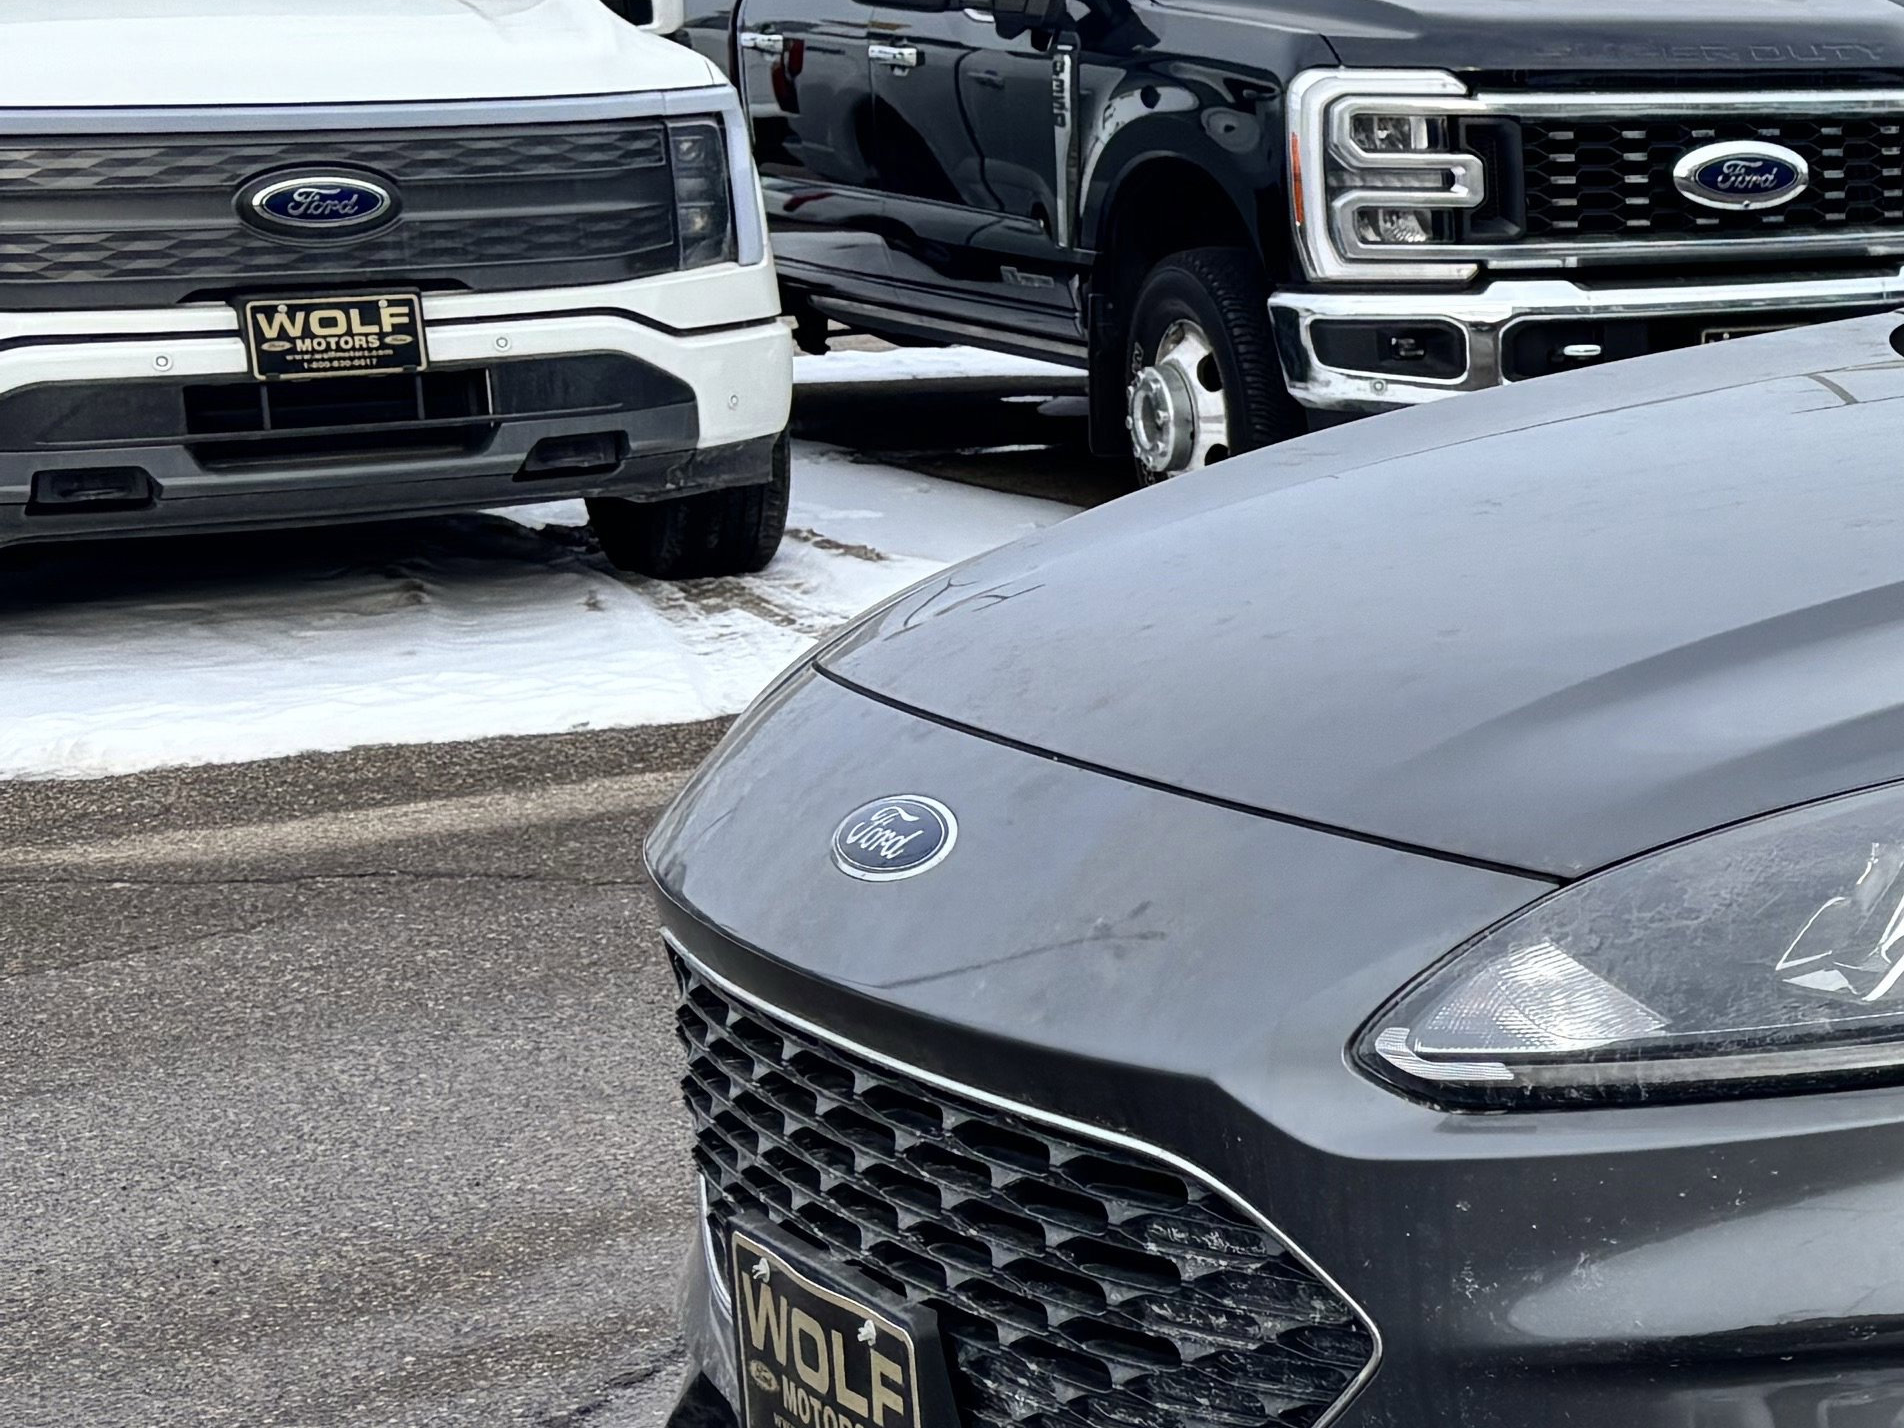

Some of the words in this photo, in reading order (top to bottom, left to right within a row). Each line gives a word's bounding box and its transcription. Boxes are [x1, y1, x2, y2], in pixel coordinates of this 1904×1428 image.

[1717, 160, 1778, 189] Ford
[287, 187, 359, 216] Ford
[256, 306, 409, 339] WOLF
[296, 335, 380, 352] MOTORS
[846, 806, 924, 859] Ford
[742, 1271, 904, 1427] WOLF
